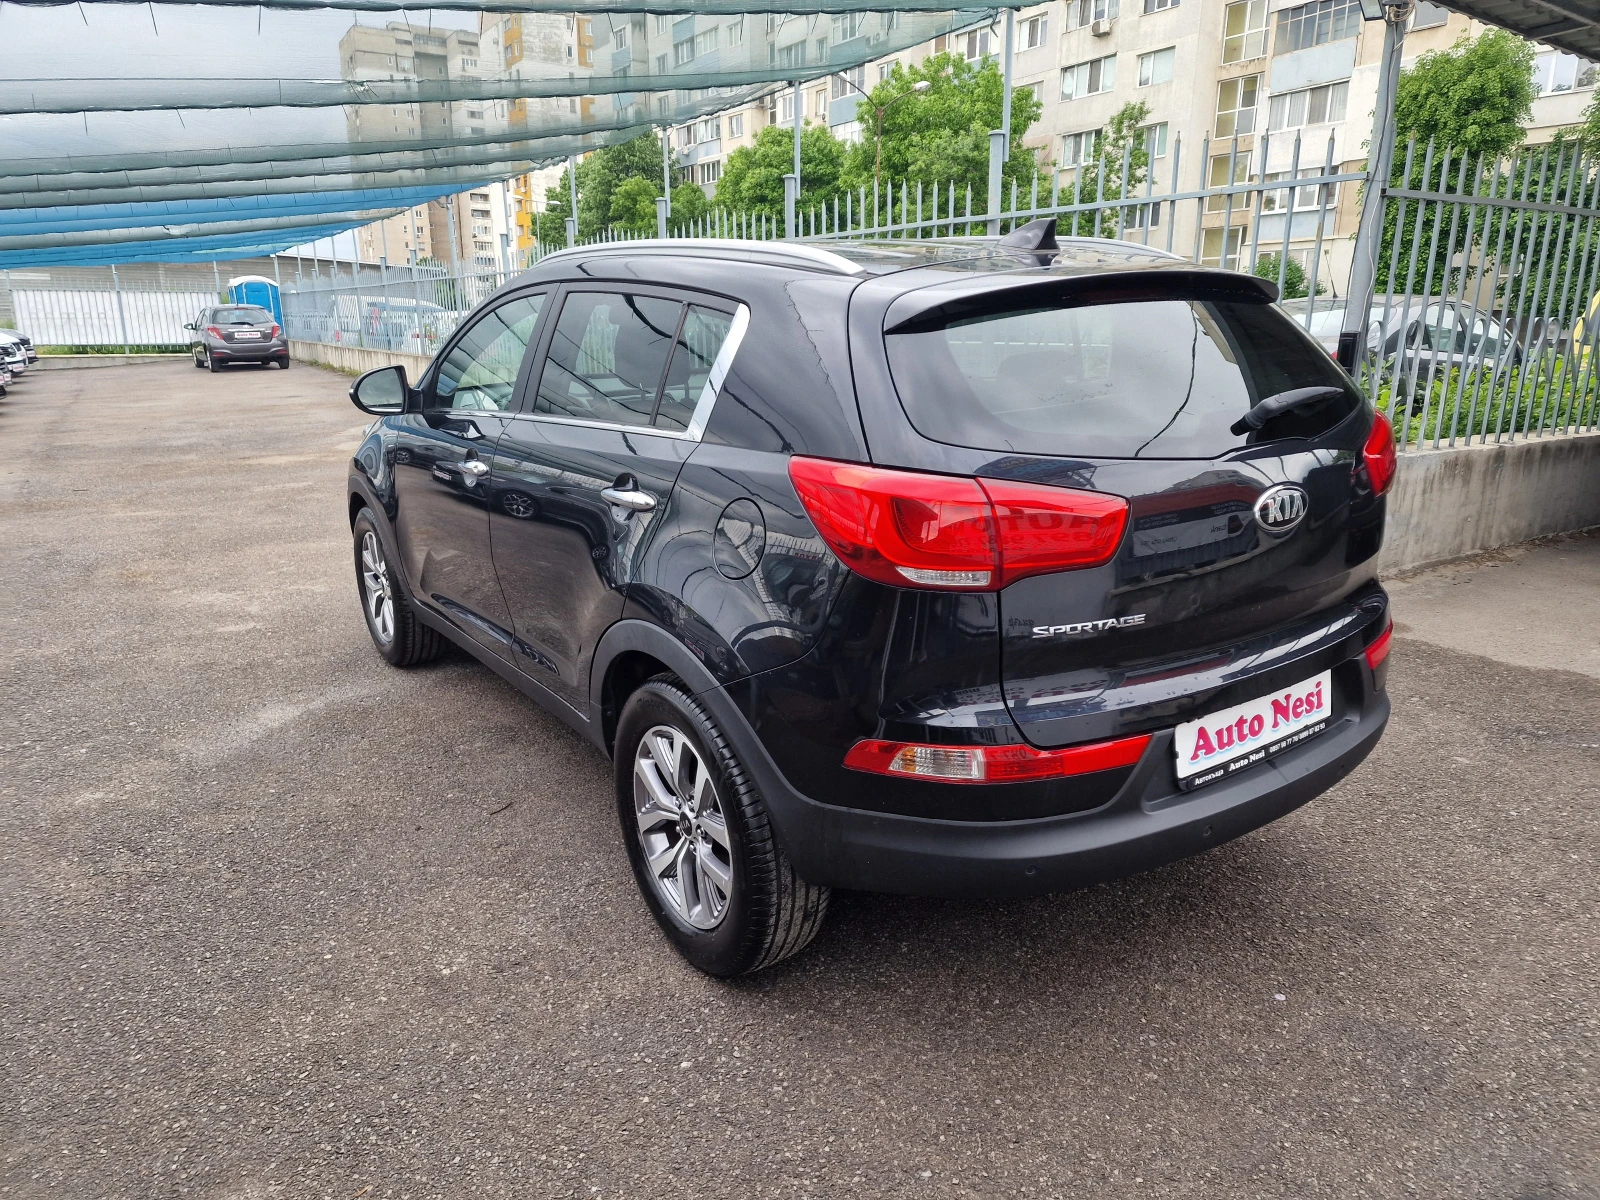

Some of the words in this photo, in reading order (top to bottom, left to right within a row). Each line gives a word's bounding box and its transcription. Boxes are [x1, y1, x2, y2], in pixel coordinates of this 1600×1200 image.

[1266, 492, 1304, 524] KIA
[1032, 613, 1147, 639] SPORTAGE
[1190, 713, 1265, 761] Auto
[1270, 680, 1324, 729] Nesi
[1228, 758, 1249, 772] Auto
[1249, 750, 1265, 763] Nesi
